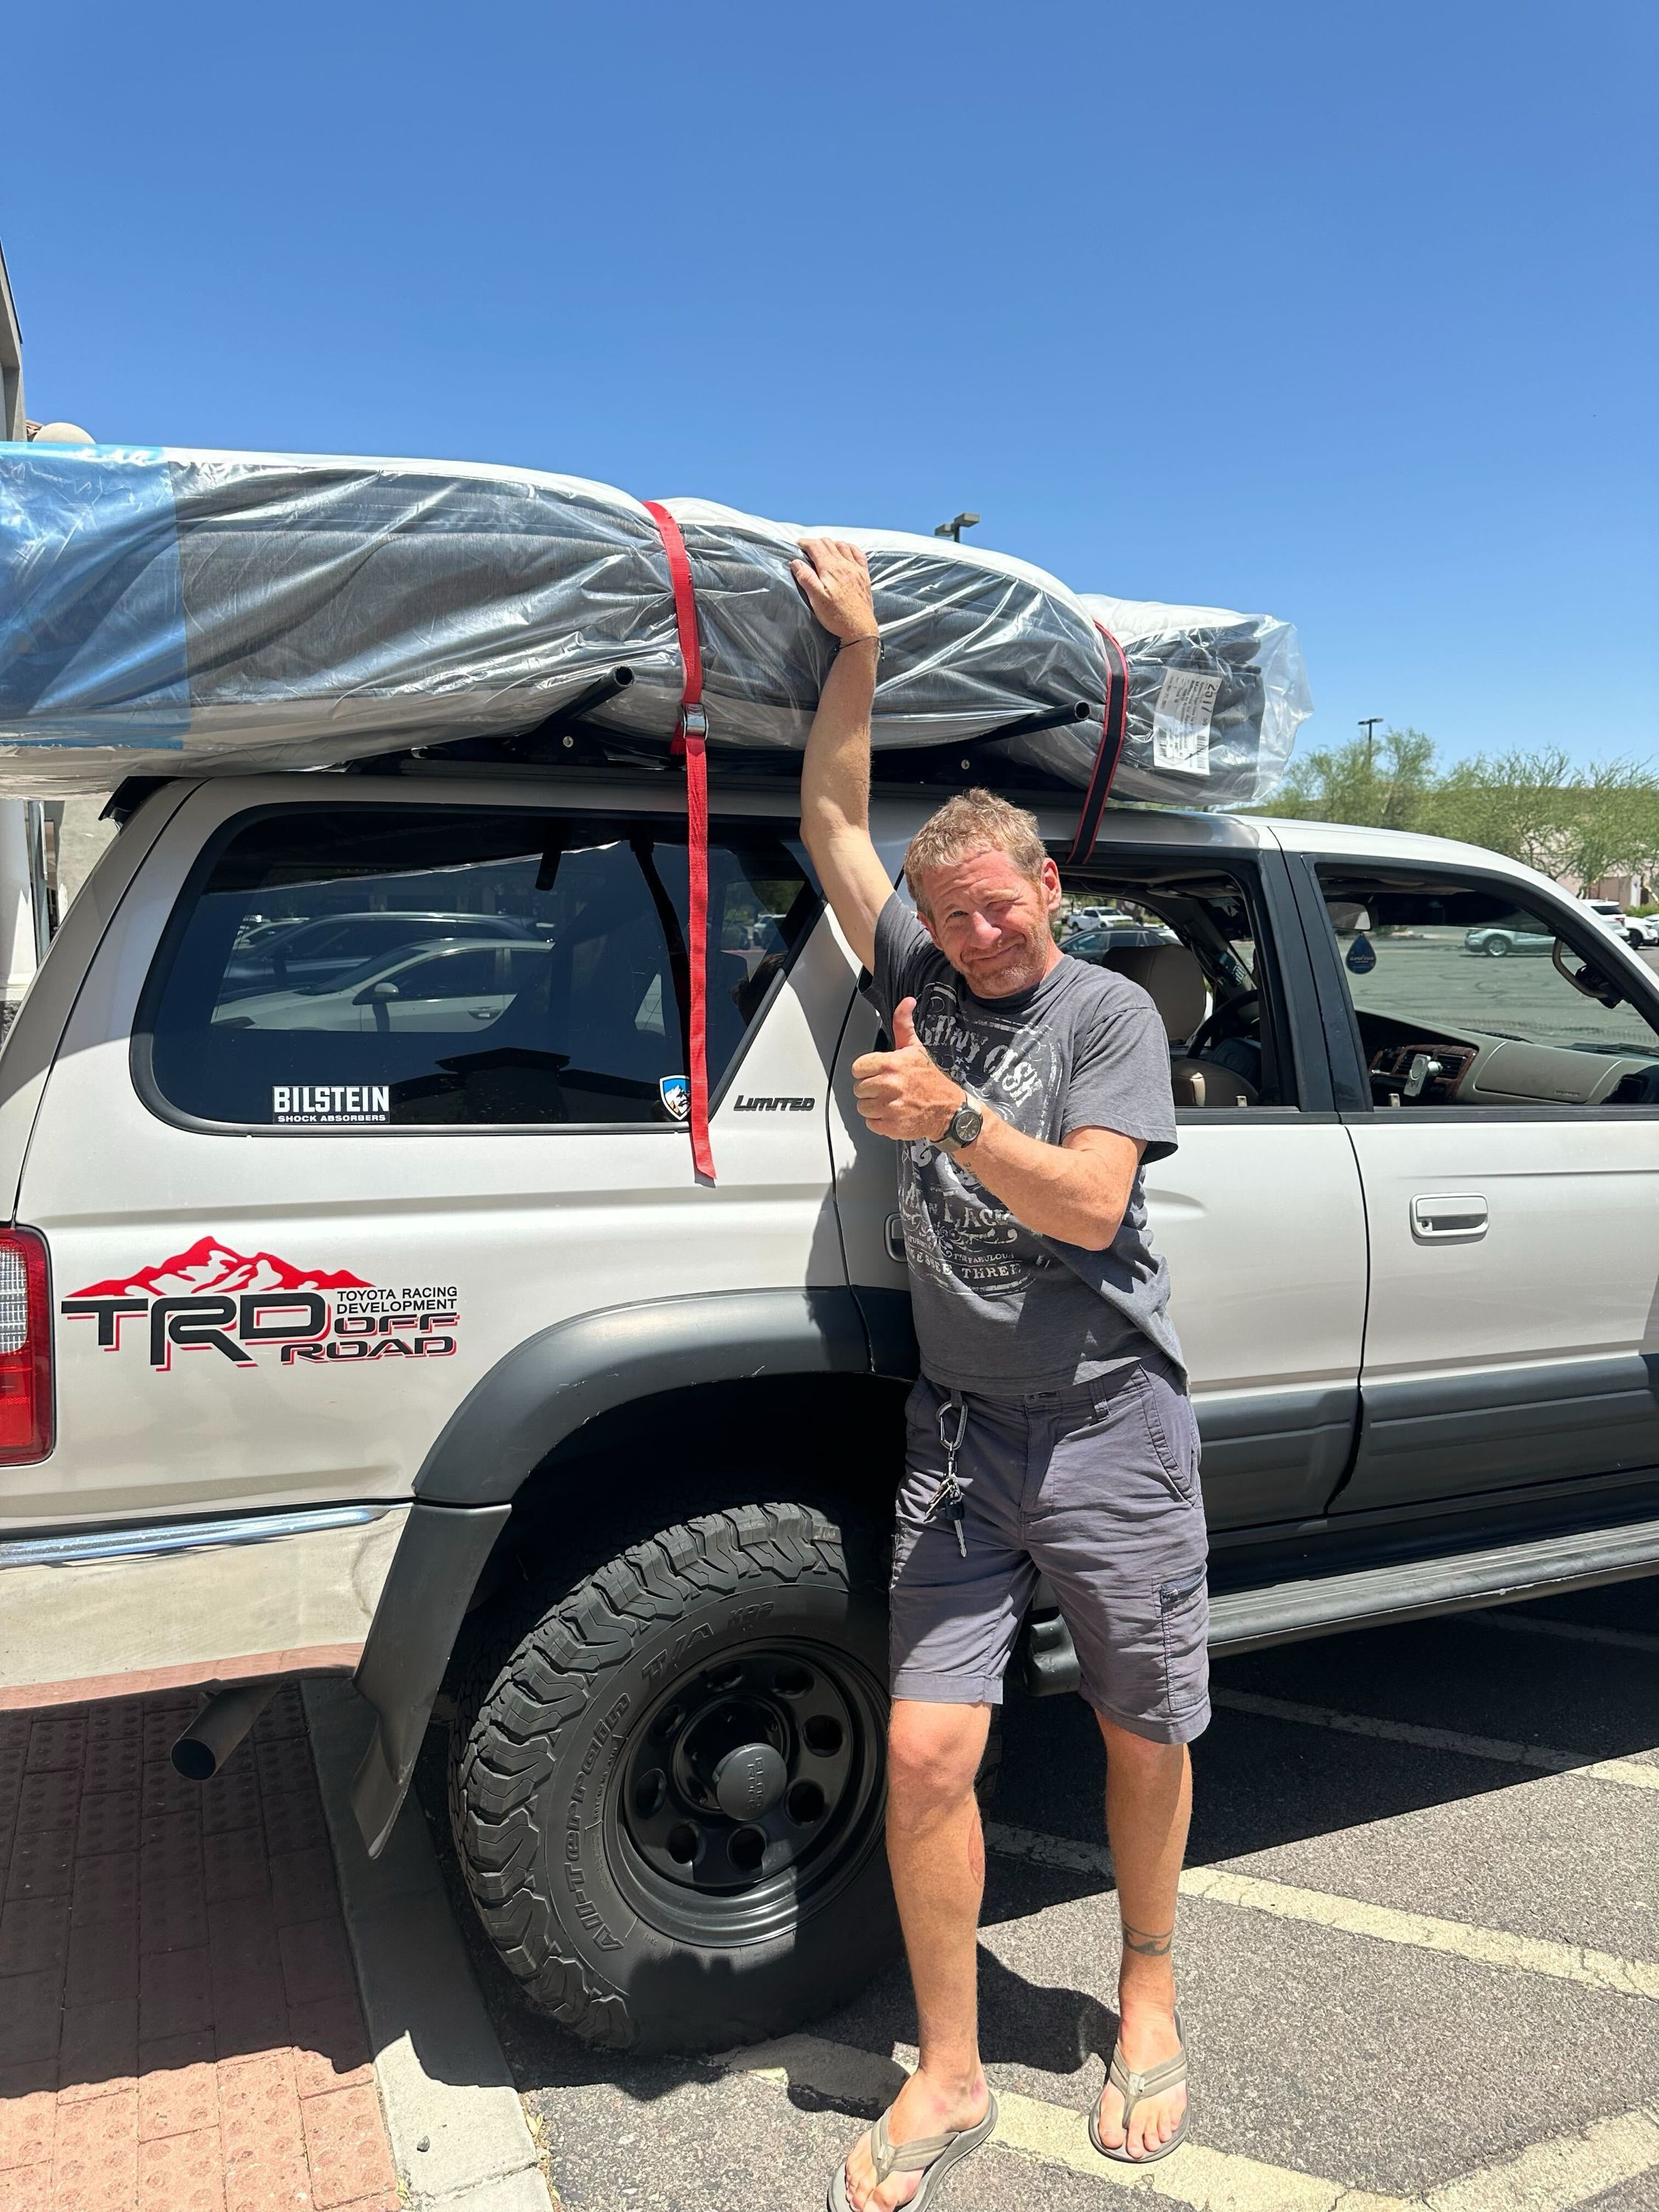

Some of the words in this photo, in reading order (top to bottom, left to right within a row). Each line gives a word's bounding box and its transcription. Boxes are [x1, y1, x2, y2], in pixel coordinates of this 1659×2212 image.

[274, 1087, 389, 1113] BILSTEIN
[734, 1095, 815, 1111] LIMITED
[961, 1264, 1021, 1279] THREE
[337, 1290, 396, 1301] TOYOTA
[402, 1286, 458, 1299] RACING
[337, 1299, 457, 1314] DEVELOPMENT
[60, 1292, 331, 1372] TRD
[334, 1312, 460, 1337] OFF
[281, 1335, 457, 1365] ROAD
